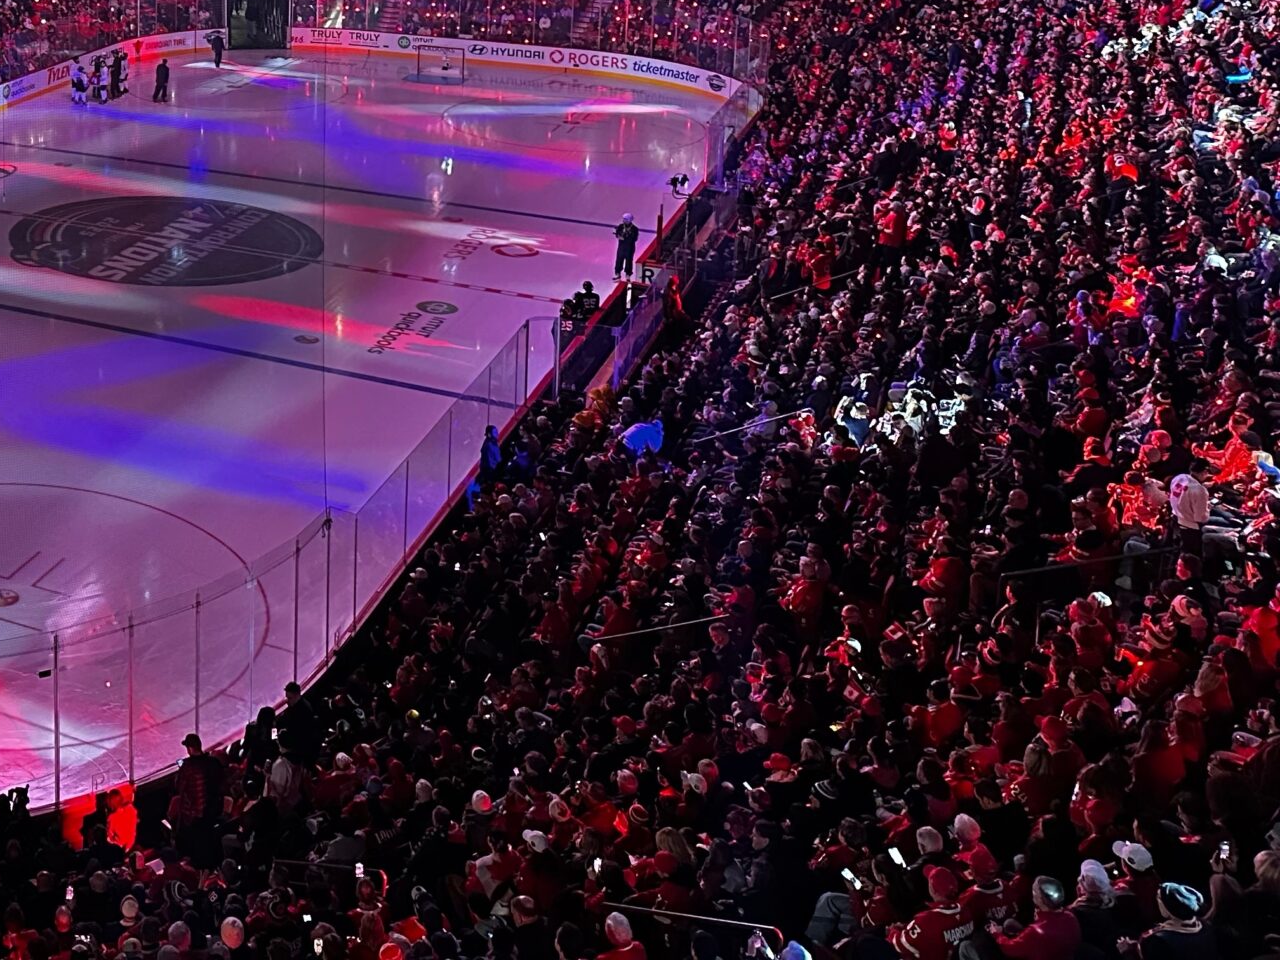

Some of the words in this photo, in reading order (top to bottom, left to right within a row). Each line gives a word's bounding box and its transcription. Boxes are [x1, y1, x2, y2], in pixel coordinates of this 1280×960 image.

[310, 29, 343, 39] TRULY
[348, 31, 380, 42] TRULY
[491, 47, 545, 60] HYUNDAI
[569, 53, 628, 70] ROGERS
[632, 61, 700, 84] ticketmaster
[87, 214, 216, 282] NATIONS
[368, 311, 422, 355] quickbooks
[416, 316, 447, 338] INTUIT
